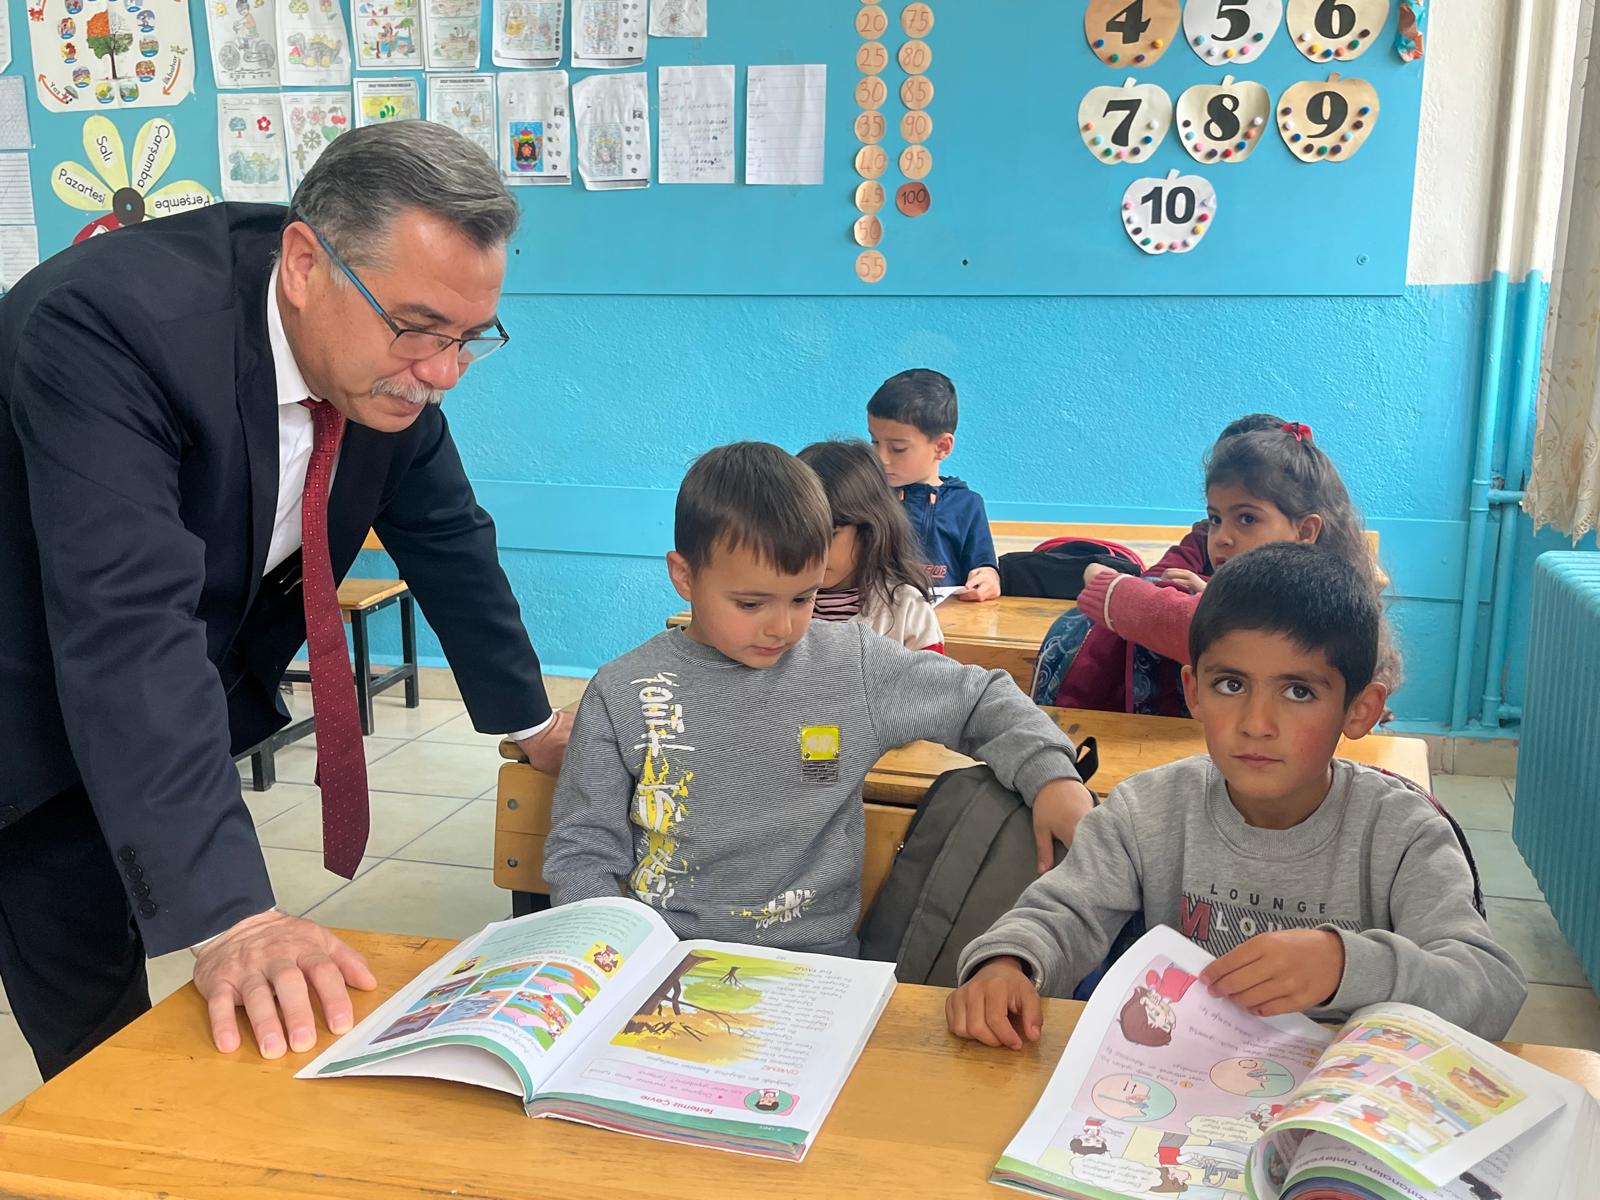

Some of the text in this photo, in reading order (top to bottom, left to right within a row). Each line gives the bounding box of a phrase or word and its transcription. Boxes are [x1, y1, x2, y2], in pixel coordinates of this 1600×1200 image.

[860, 13, 885, 32] 20
[907, 10, 929, 33] 75
[1106, 0, 1151, 44] 4
[1211, 0, 1250, 42] 5
[1314, 0, 1356, 39] 6
[860, 48, 885, 66] 25
[903, 48, 924, 67] 80
[861, 82, 884, 101] 30
[904, 82, 928, 101] 85
[904, 115, 926, 136] 90
[1102, 99, 1142, 147] 7
[1204, 94, 1240, 142] 8
[1306, 90, 1348, 139] 9
[859, 116, 883, 137] 35
[96, 135, 112, 162] Salı
[137, 124, 171, 189] Çarşamba
[904, 152, 925, 171] 95
[58, 168, 106, 204] Pazartesi
[902, 188, 926, 206] 100
[155, 194, 210, 213] Perşembe
[1140, 186, 1196, 224] 10
[859, 221, 881, 240] 50
[858, 256, 884, 274] 55
[1210, 883, 1327, 914] LOUNGE
